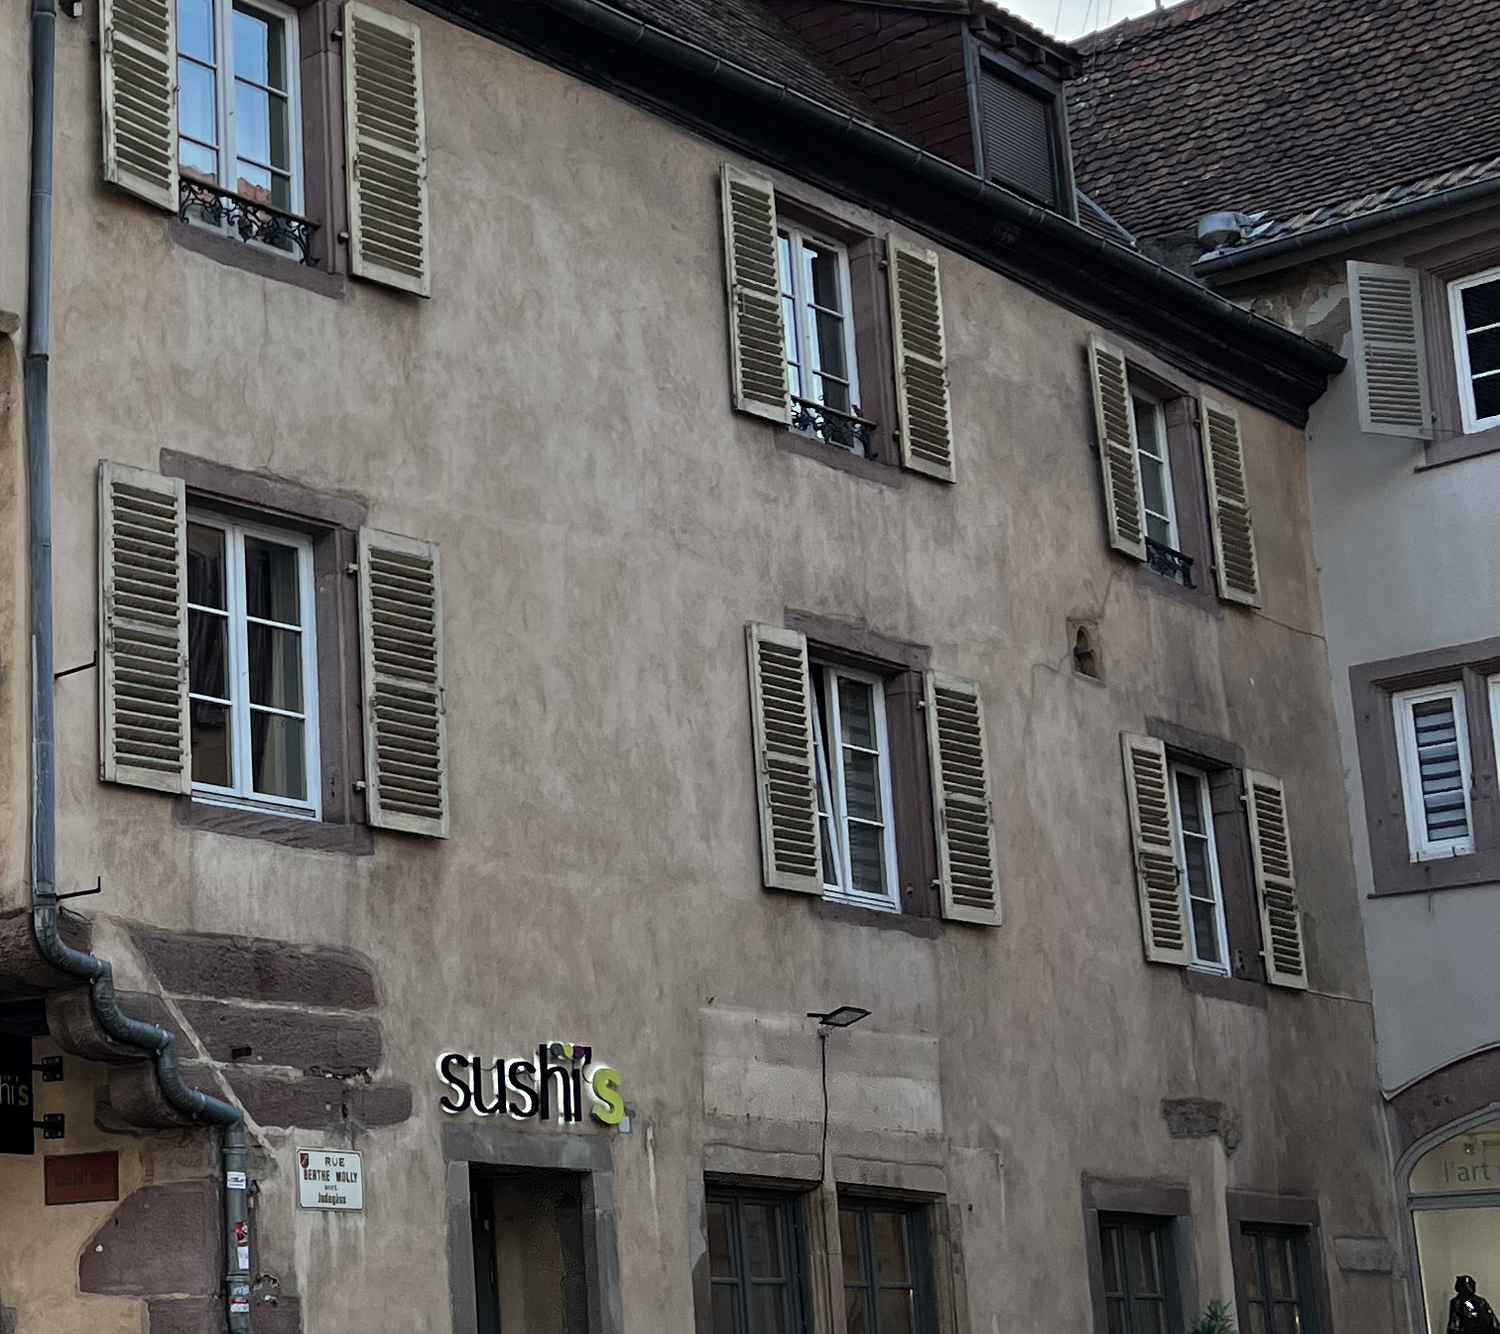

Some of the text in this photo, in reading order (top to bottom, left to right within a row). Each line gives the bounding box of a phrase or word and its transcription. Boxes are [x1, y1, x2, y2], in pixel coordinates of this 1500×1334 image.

[438, 1043, 624, 1125] sushi's
[325, 1157, 345, 1167] RUE
[1443, 1160, 1491, 1183] l'art
[303, 1168, 358, 1183] BERTHE MOLLY
